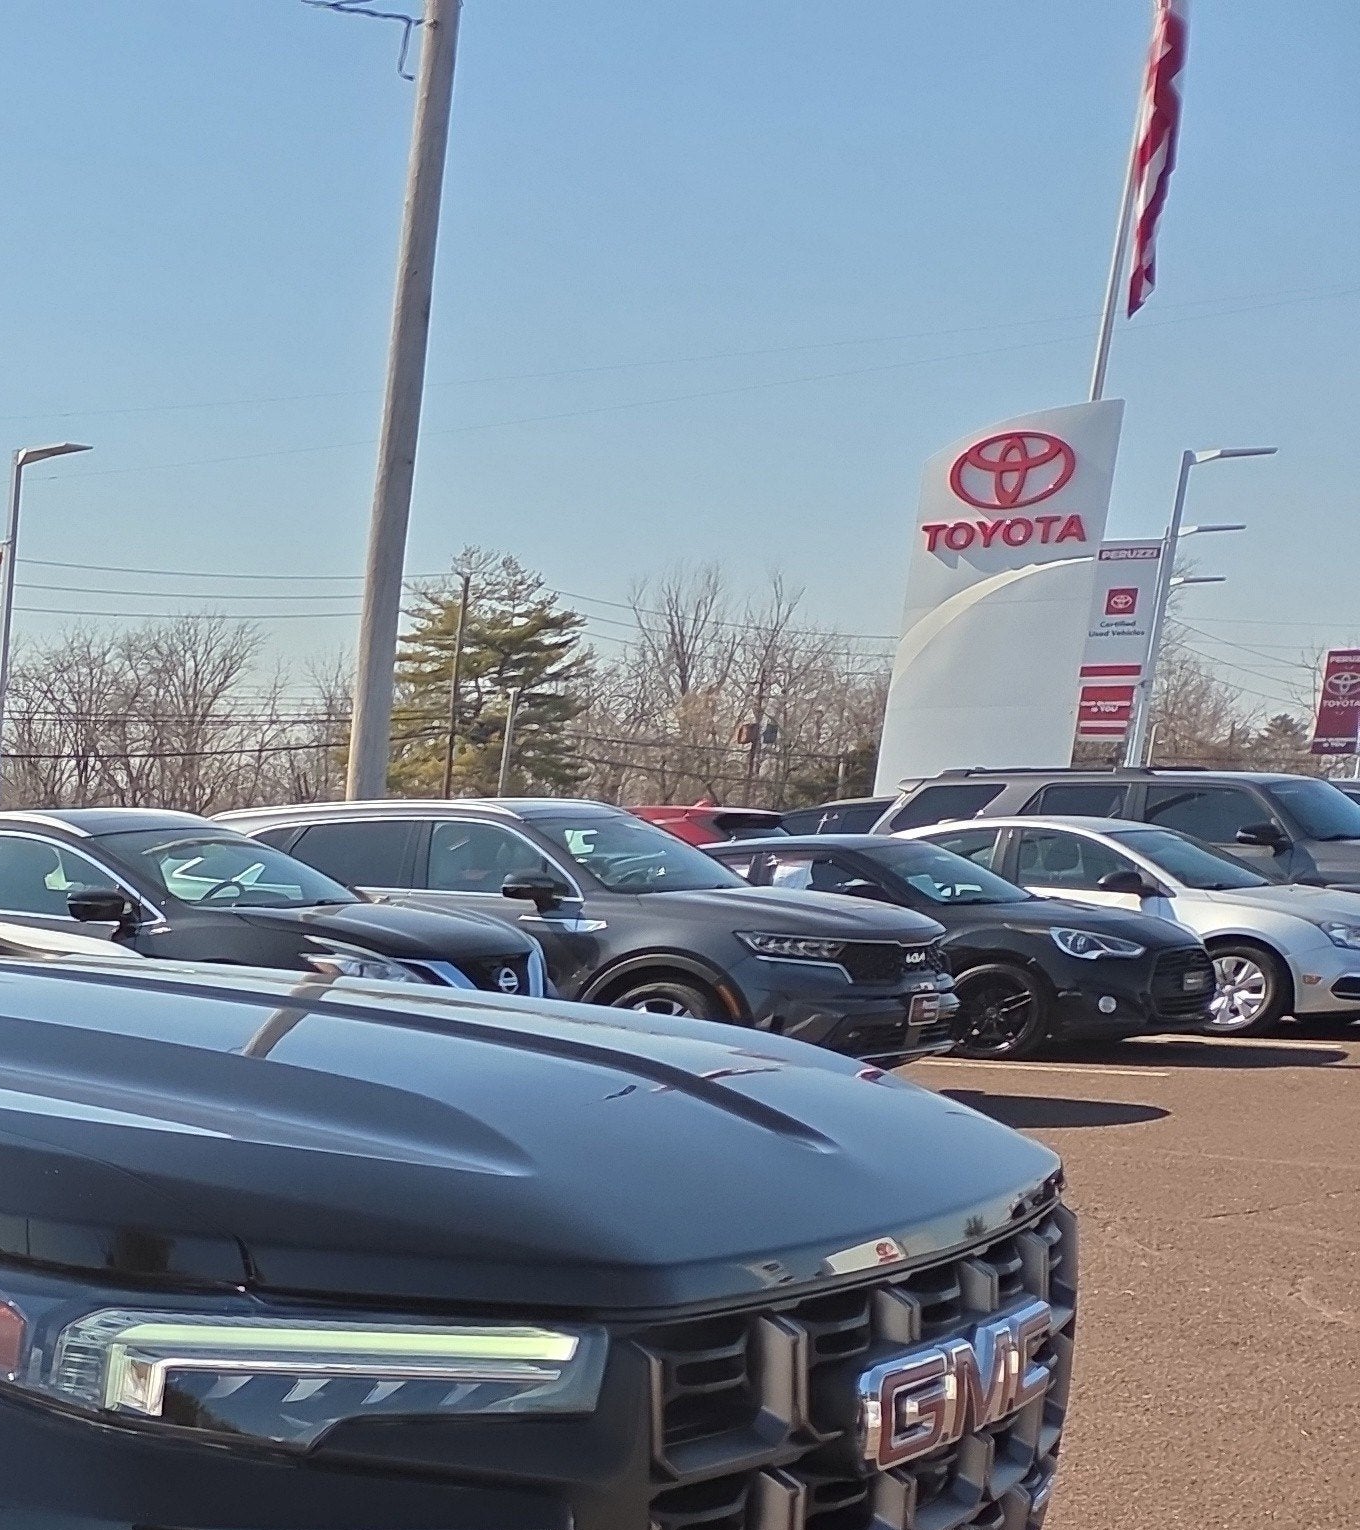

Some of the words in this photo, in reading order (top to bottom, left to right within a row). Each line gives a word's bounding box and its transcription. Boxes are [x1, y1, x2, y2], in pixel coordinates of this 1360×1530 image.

[921, 514, 1087, 552] TOYOTA
[1101, 549, 1158, 560] PERUZZI
[1100, 620, 1136, 628] Certified
[1111, 629, 1145, 637] Vehicles
[856, 1300, 1052, 1472] GMC
